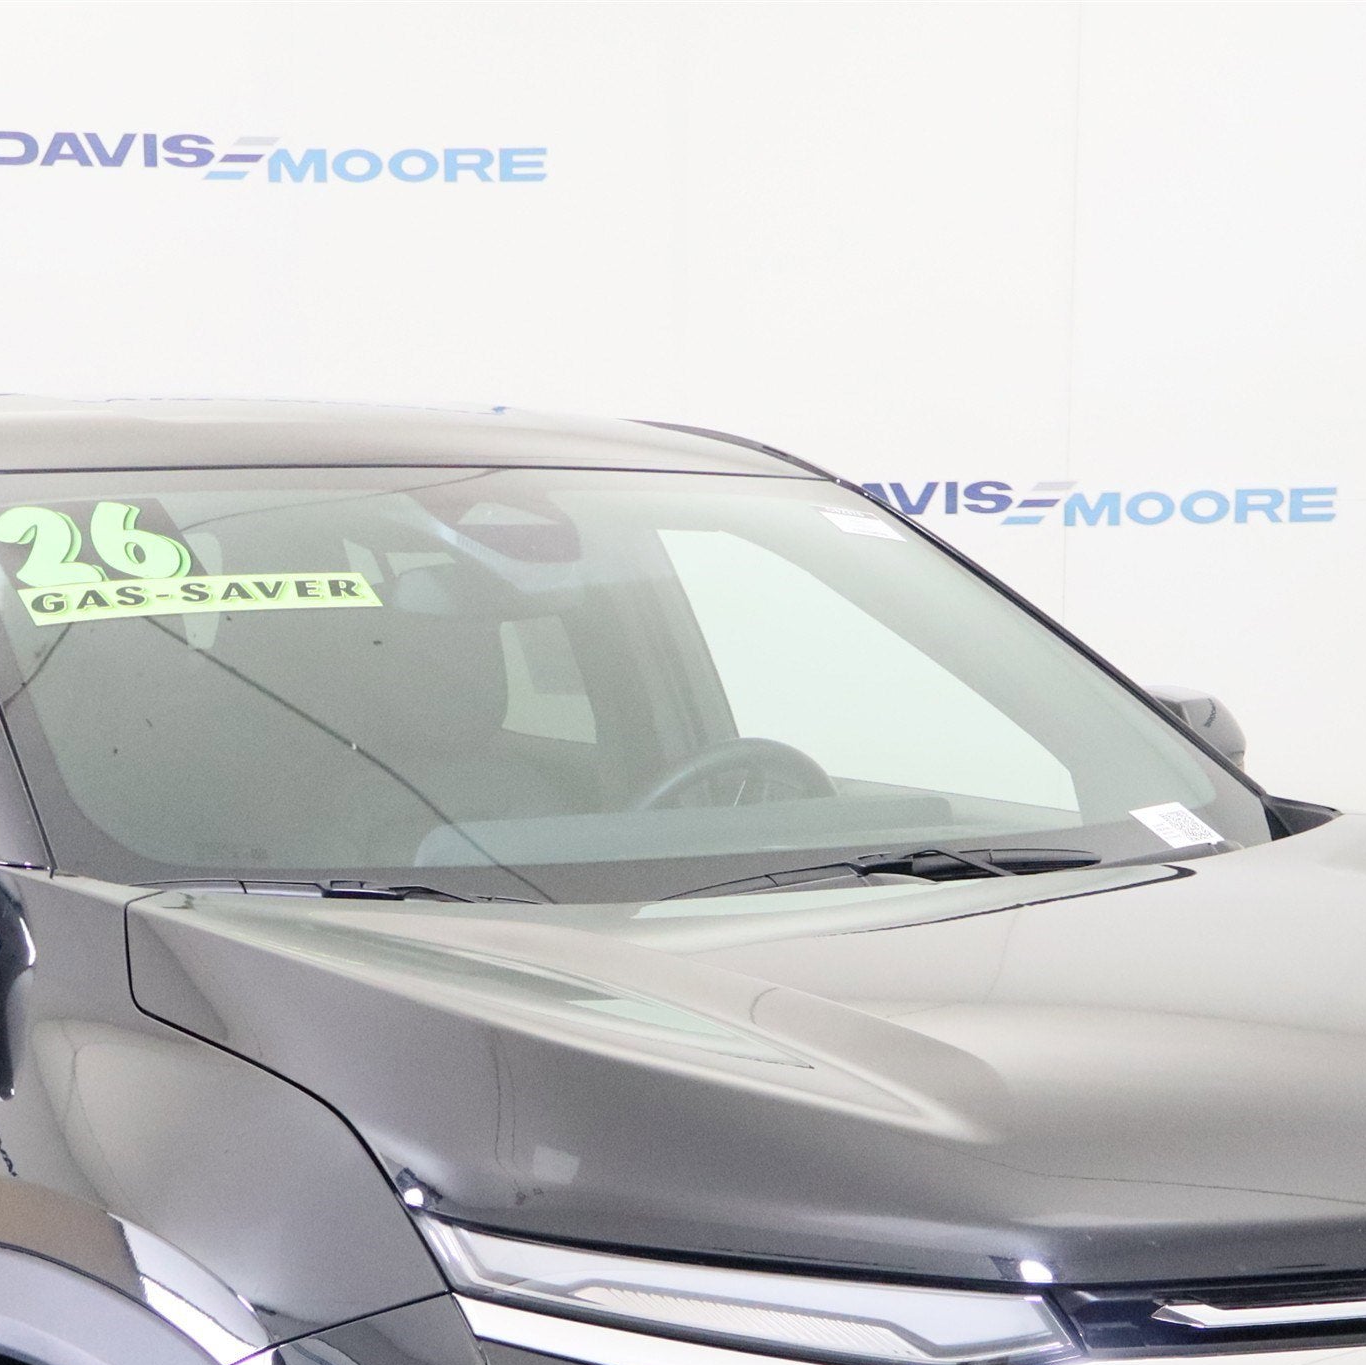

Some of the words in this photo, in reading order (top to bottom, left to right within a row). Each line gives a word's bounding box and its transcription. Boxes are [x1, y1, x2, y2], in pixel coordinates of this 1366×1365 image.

[267, 147, 548, 184] MOORE
[1063, 486, 1337, 527] MOORE
[30, 577, 364, 616] GAS-SAVER
